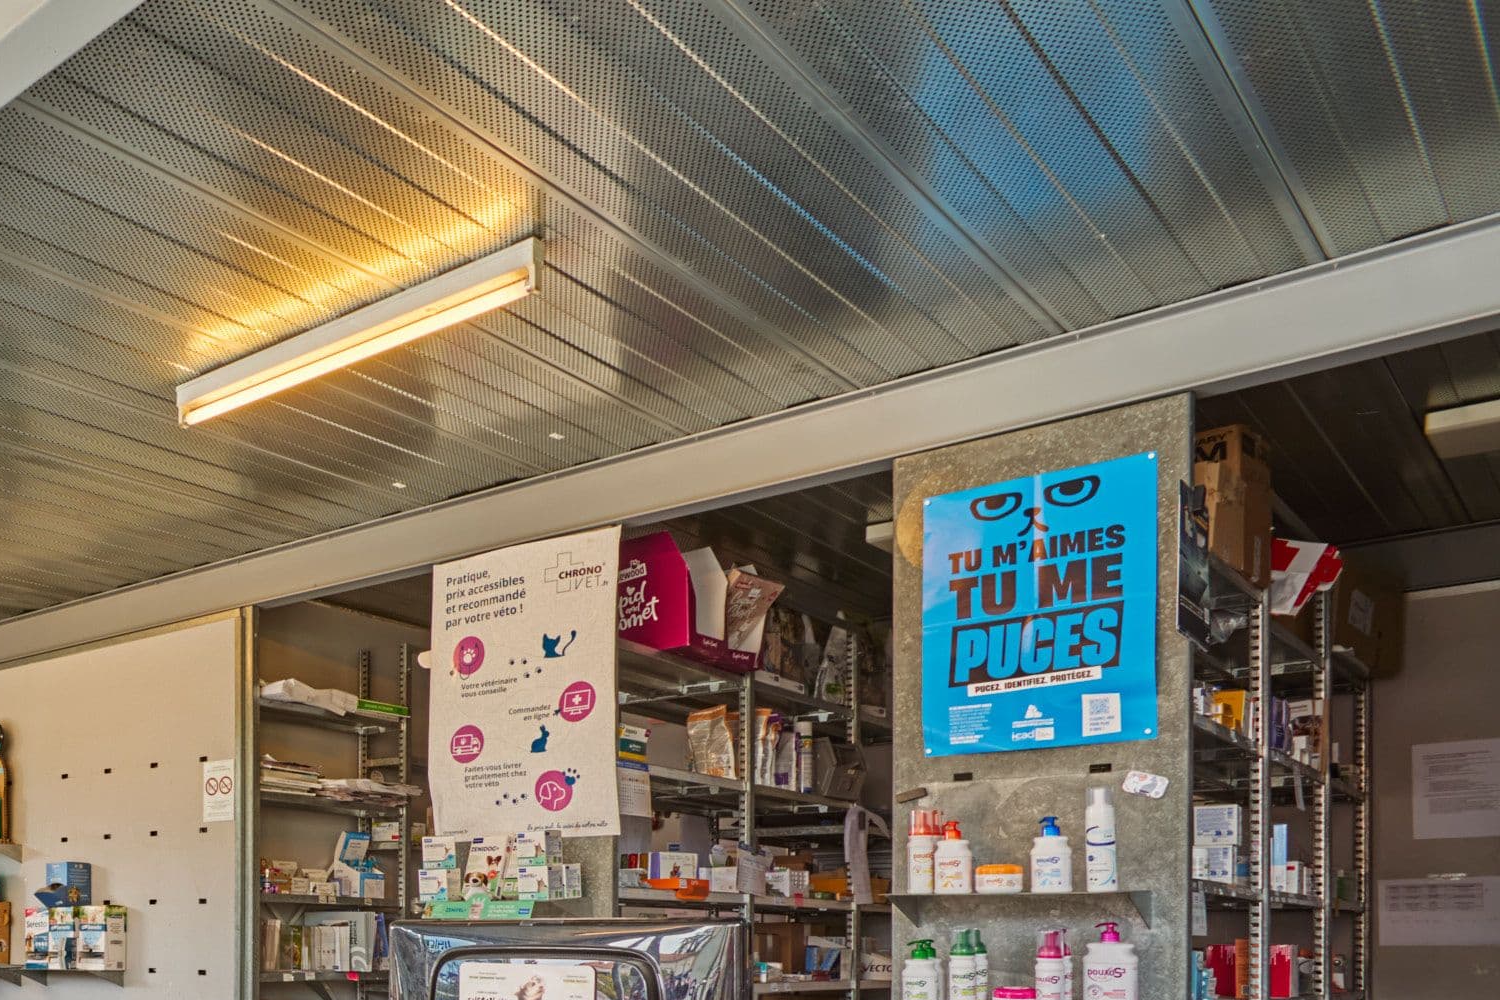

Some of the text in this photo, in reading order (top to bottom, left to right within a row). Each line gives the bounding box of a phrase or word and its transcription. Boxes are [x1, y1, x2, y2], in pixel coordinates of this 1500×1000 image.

[949, 523, 1126, 574] TU M'AIMES
[446, 568, 491, 588] Pratique,
[558, 564, 603, 580] CHRONO
[446, 575, 525, 603] prix accessibles
[949, 552, 1123, 620] TU ME
[445, 588, 526, 615] et recommandé
[445, 617, 462, 631] par
[464, 611, 491, 625] votre
[493, 604, 517, 618] véto
[619, 596, 660, 631] omet
[953, 606, 1120, 684] PUCES
[461, 677, 518, 690] Votre vétérinaire
[1004, 677, 1047, 690] IDENTIFIEZ.
[1051, 669, 1093, 683] PROTÉGEZ.
[461, 687, 507, 698] vous conseille
[508, 704, 551, 715] Commandez
[534, 713, 550, 721] ligne
[464, 770, 527, 782] gratuitement chez
[503, 762, 523, 770] livrer
